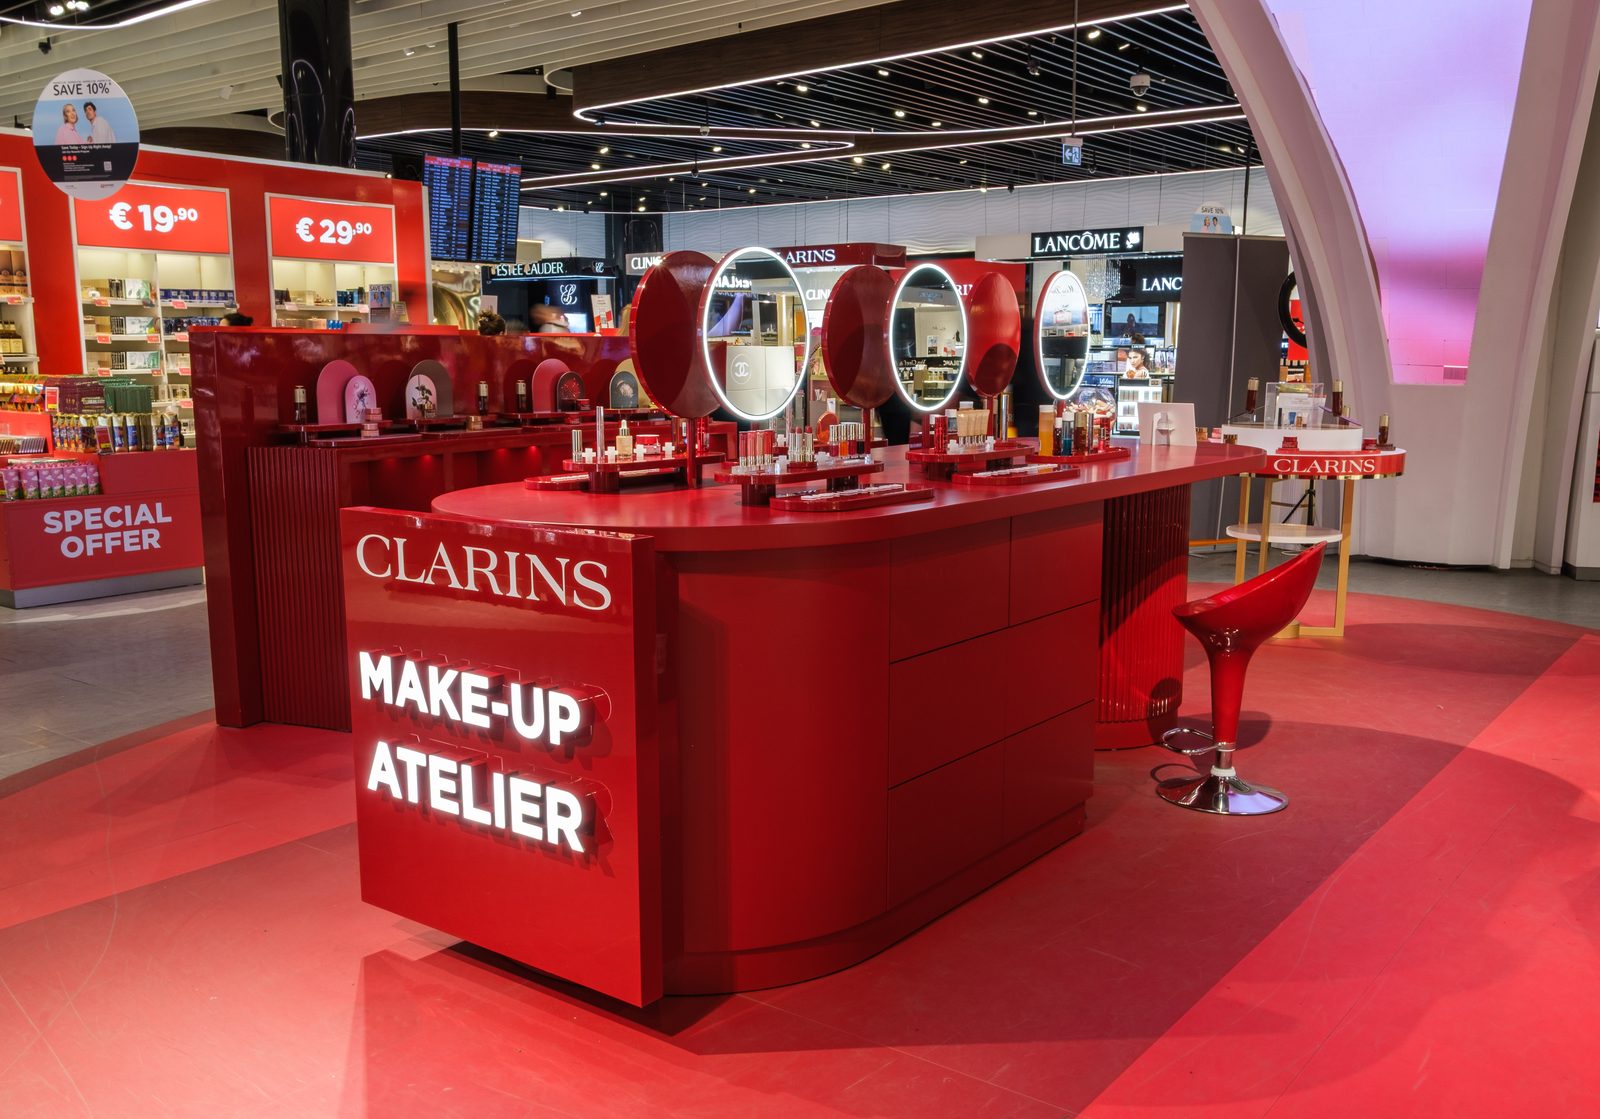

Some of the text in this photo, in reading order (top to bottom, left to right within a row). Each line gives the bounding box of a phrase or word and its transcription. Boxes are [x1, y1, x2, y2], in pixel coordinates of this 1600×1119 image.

[53, 84, 83, 96] SAVE
[109, 202, 134, 230] €
[296, 217, 315, 242] €
[778, 249, 836, 263] ARINS
[1034, 231, 1121, 253] LANCÔME
[1273, 459, 1375, 473] CLARINS
[43, 502, 172, 534] SPECIAL
[60, 528, 161, 558] OFFER
[356, 534, 611, 611] CLARINS
[358, 651, 581, 746] MAKE-UP
[367, 741, 585, 853] ATELIER
